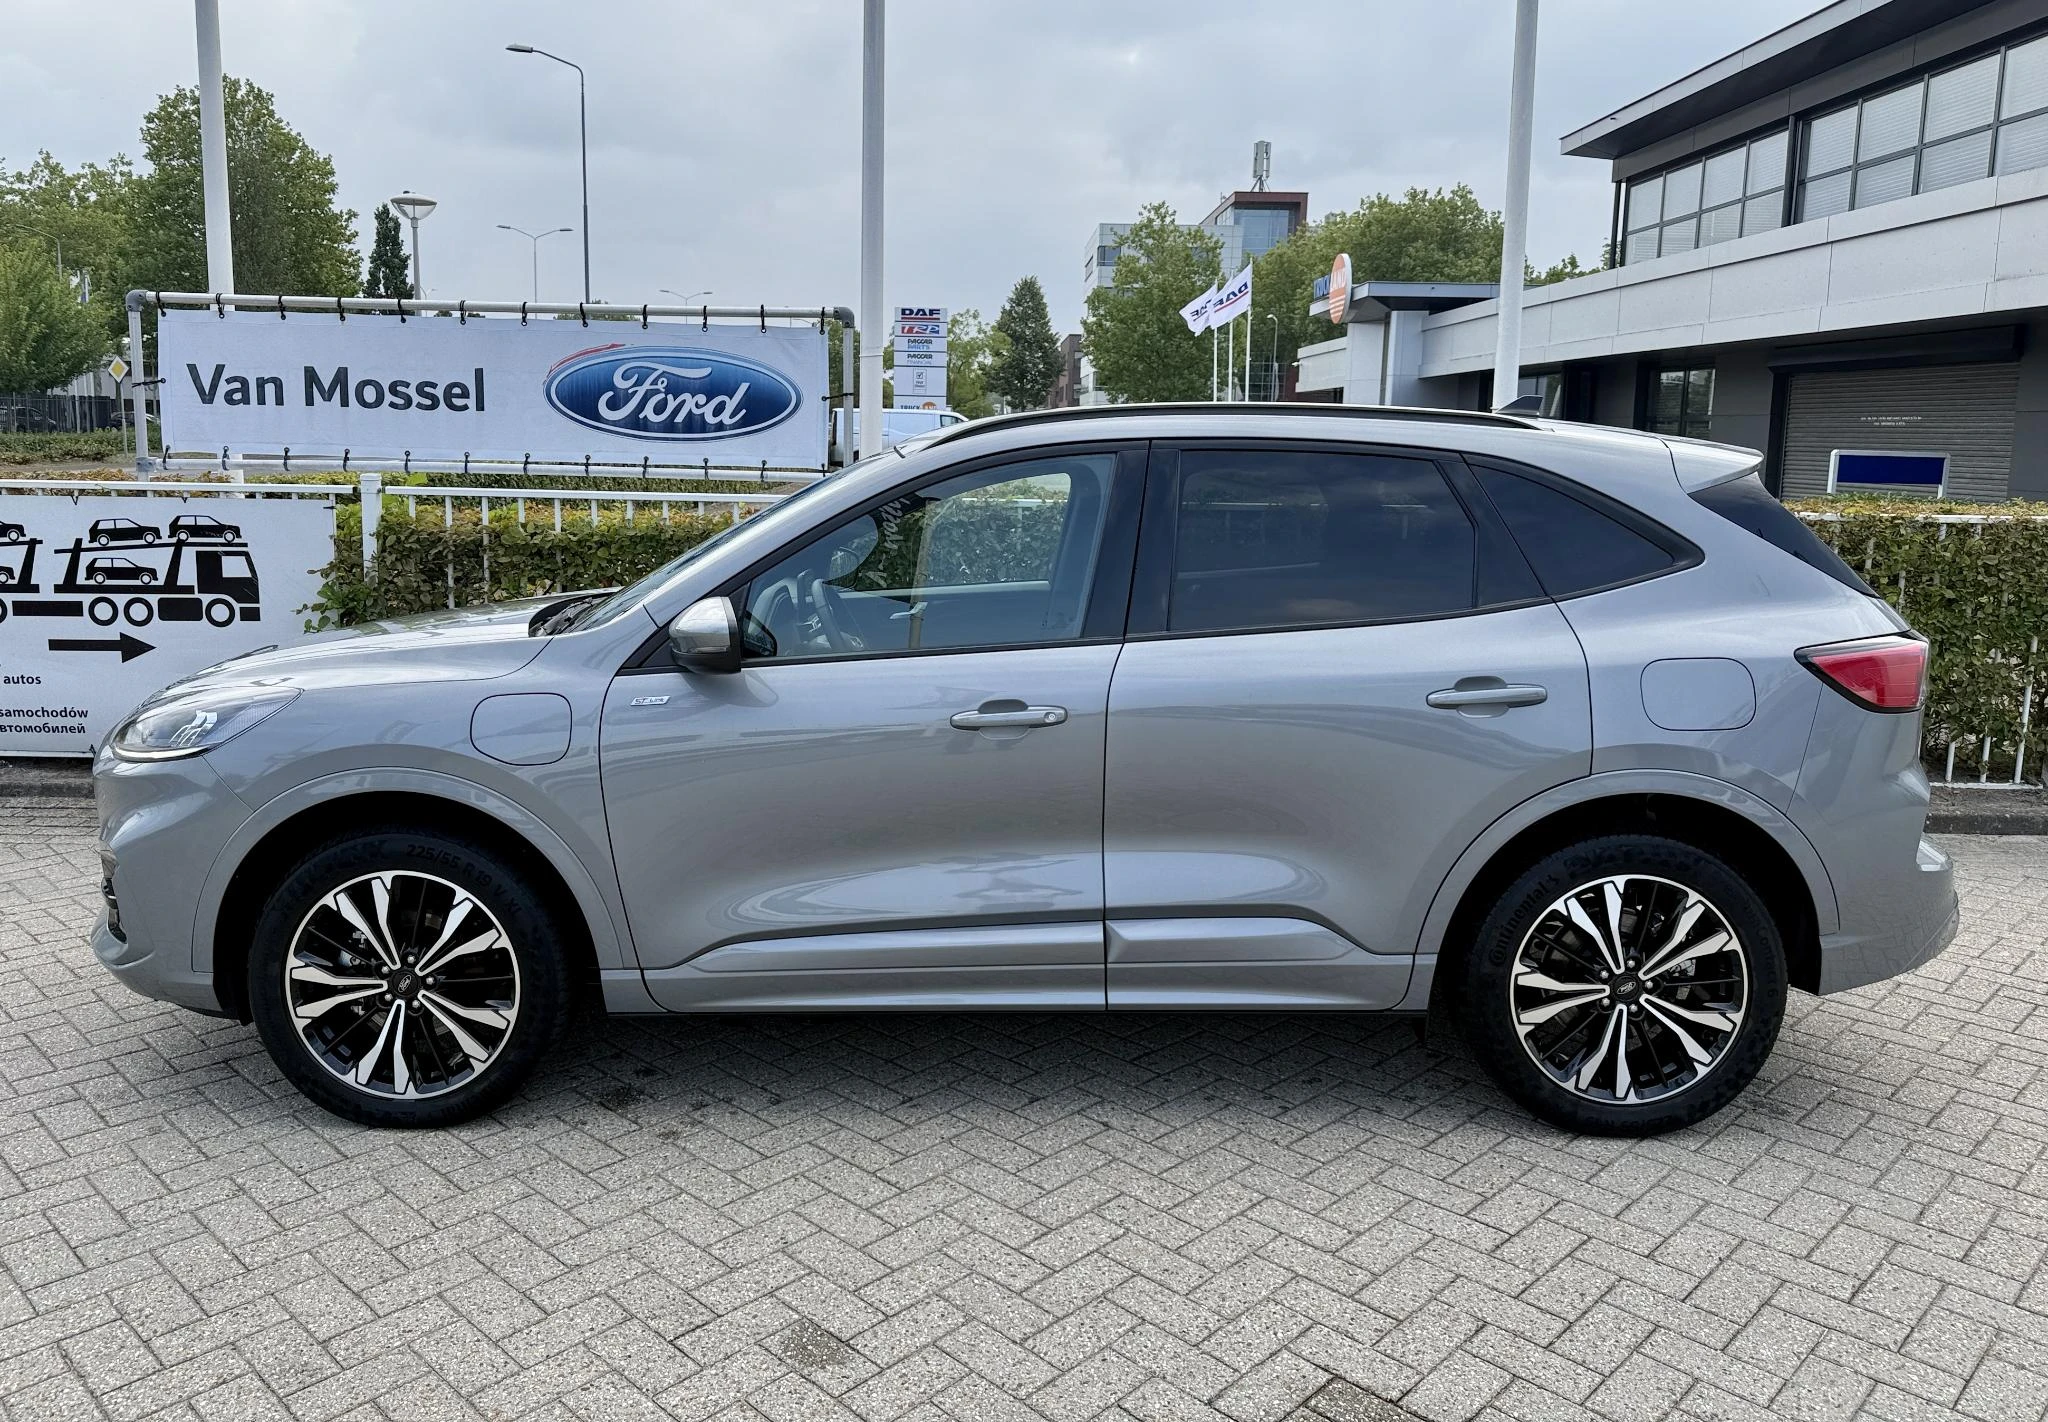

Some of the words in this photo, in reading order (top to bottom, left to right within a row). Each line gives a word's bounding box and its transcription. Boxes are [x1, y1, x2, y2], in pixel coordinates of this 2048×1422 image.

[901, 308, 940, 316] DAF
[901, 324, 939, 334] TRP
[186, 363, 285, 406] Van
[303, 365, 486, 412] Mossel
[597, 361, 751, 426] Ford
[3, 674, 42, 685] autos
[406, 843, 461, 869] 225/55
